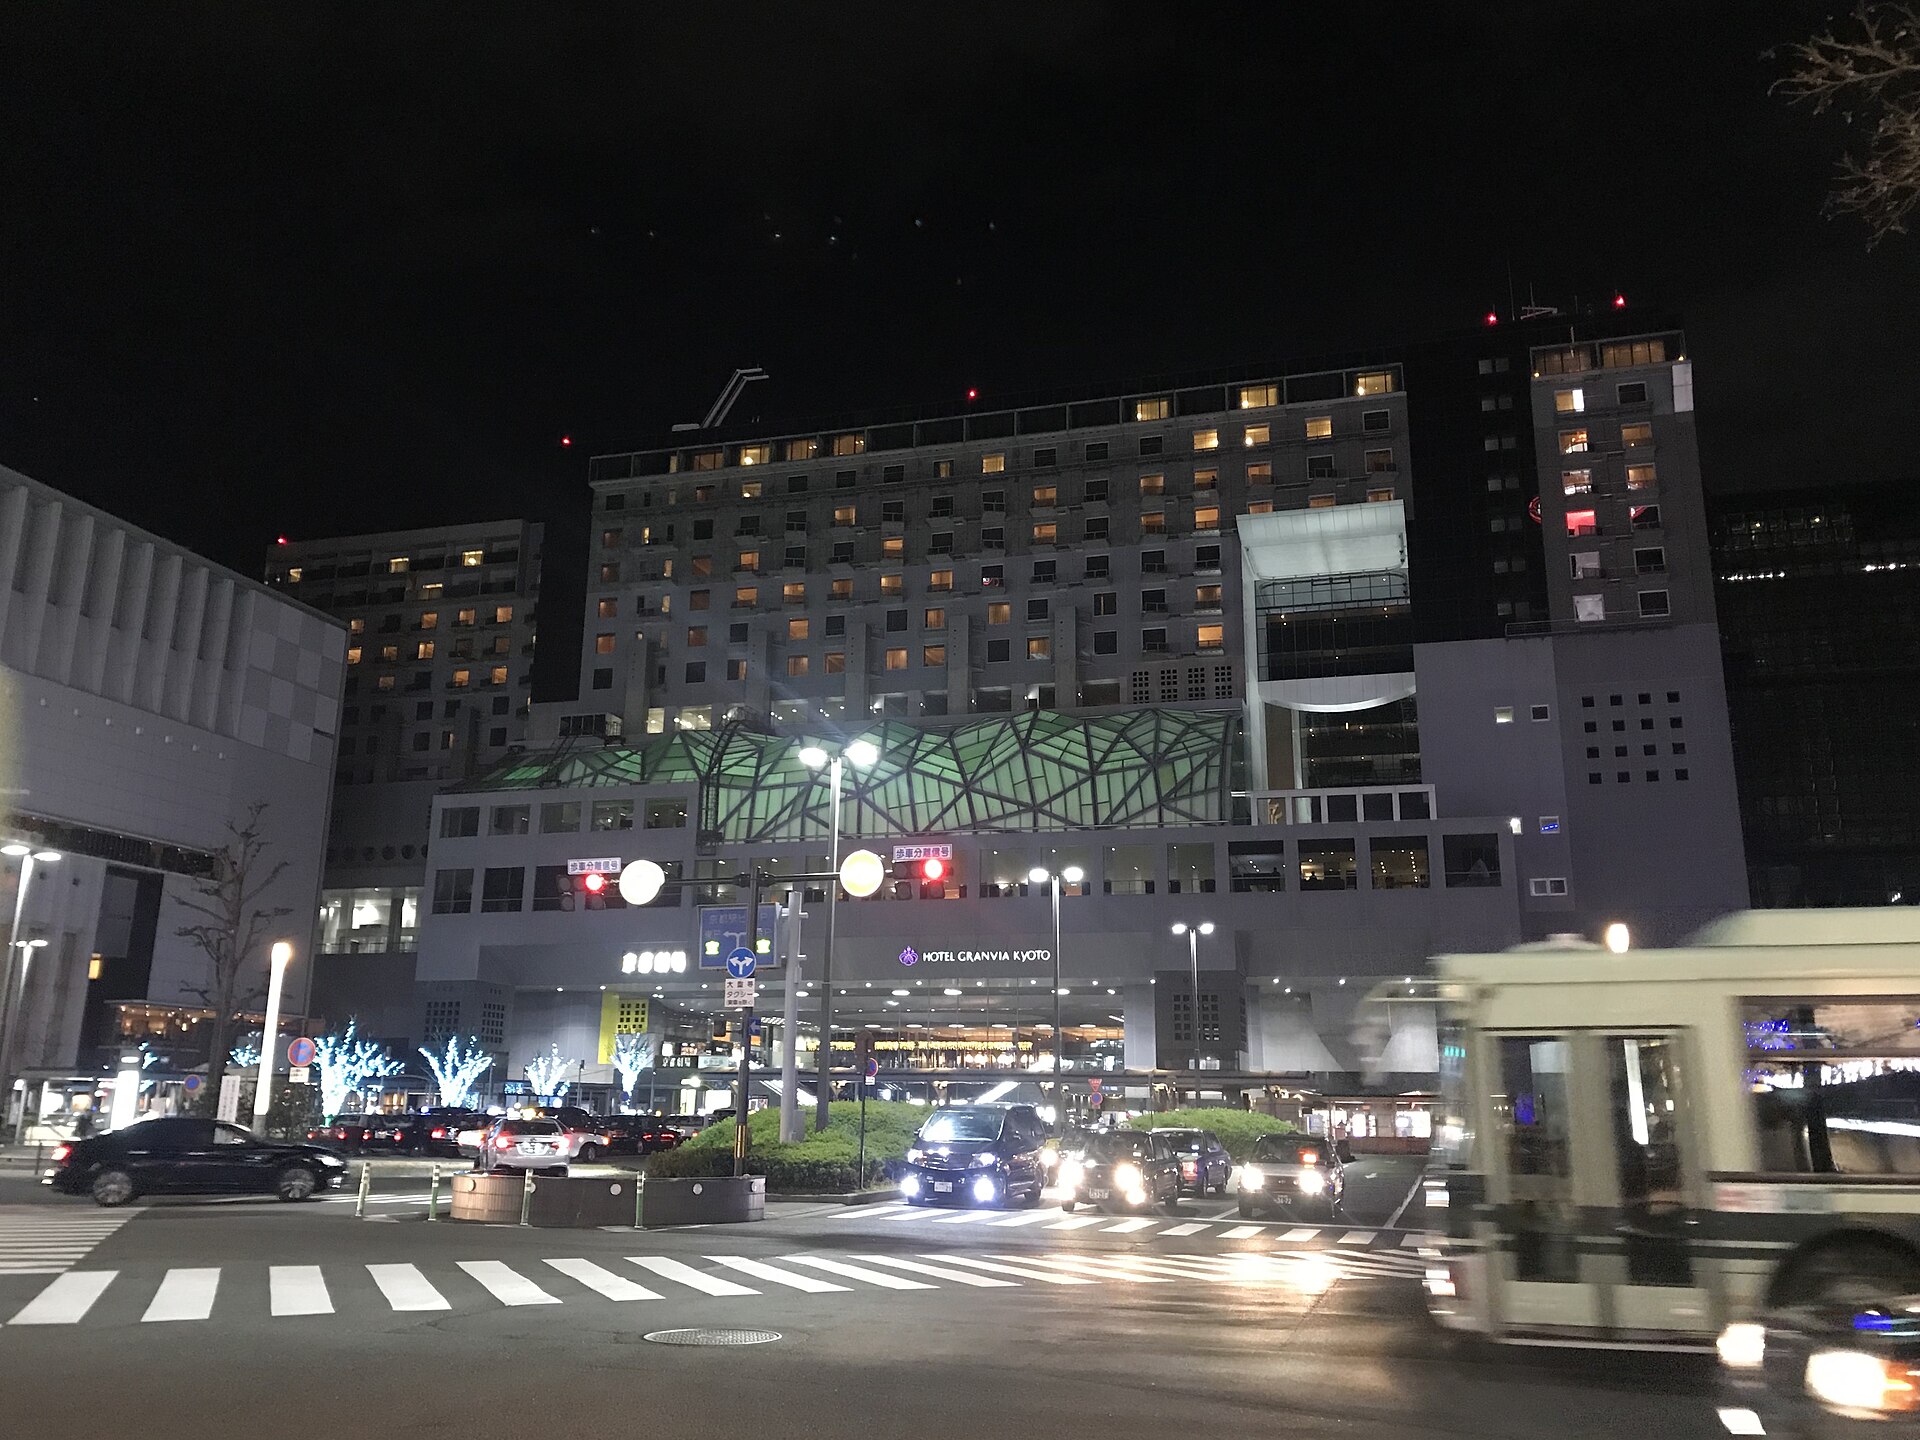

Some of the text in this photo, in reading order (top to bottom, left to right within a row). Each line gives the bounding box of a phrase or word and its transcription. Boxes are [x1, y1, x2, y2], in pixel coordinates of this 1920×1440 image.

[896, 847, 949, 858] 歩車分離信号
[922, 951, 955, 962] HOTEL
[957, 951, 1010, 962] GRANVIA
